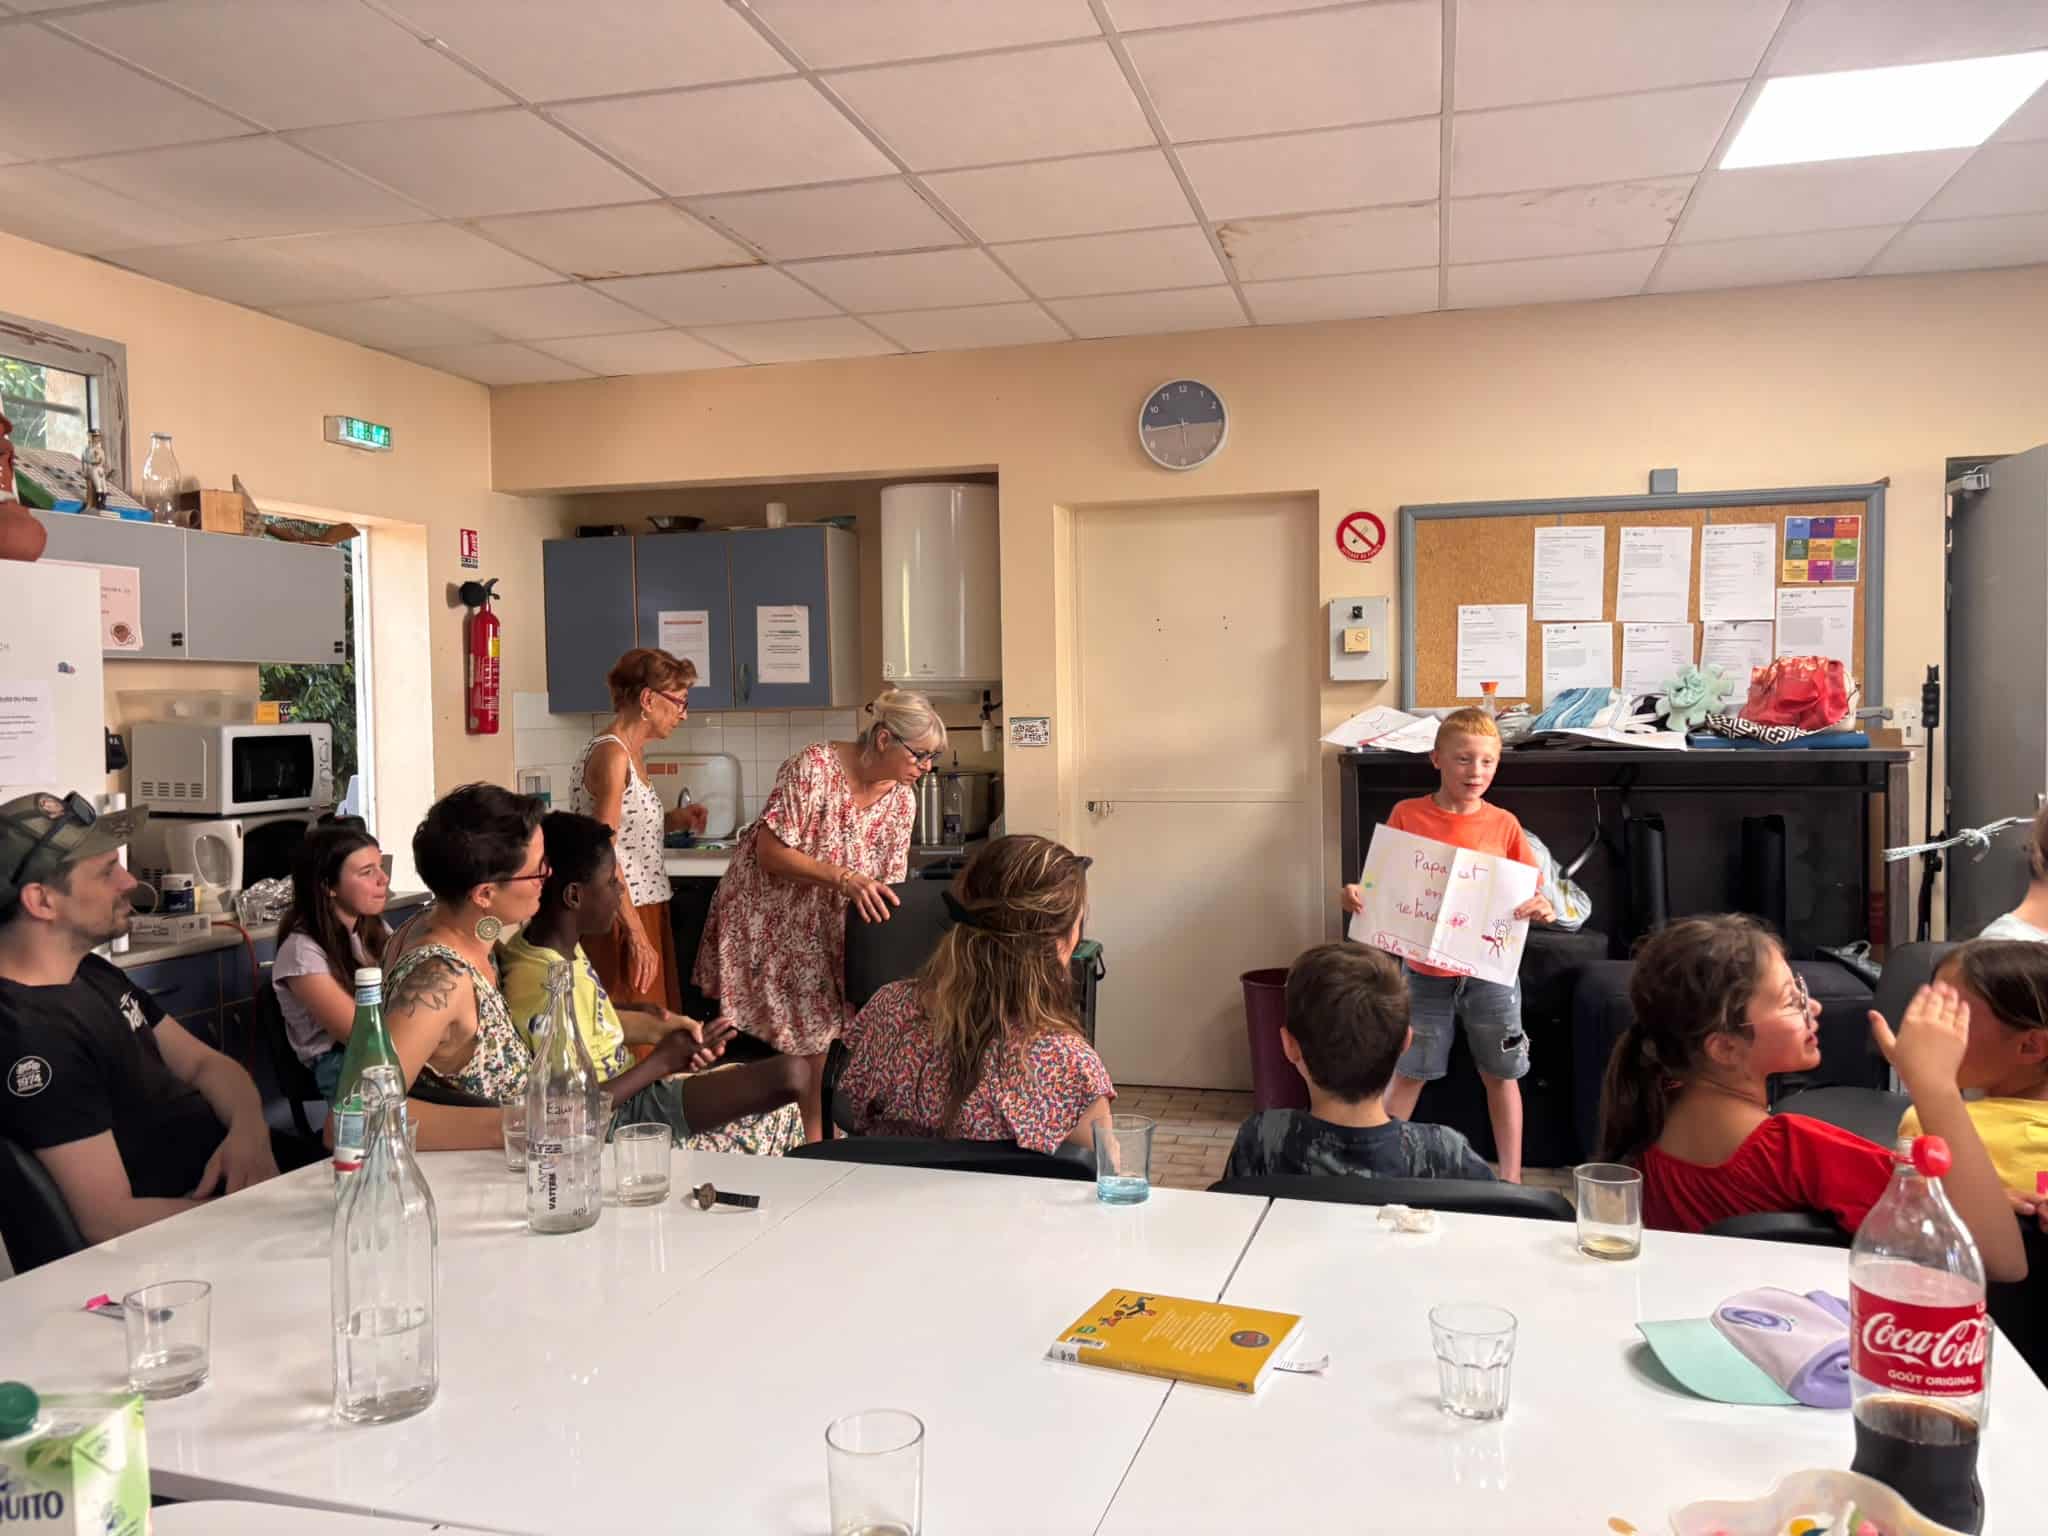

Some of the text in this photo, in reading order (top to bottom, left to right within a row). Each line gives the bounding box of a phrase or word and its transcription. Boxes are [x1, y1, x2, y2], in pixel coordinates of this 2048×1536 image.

[1178, 384, 1188, 393] 12
[1161, 392, 1170, 401] 11
[1211, 400, 1217, 409] 2
[1150, 405, 1160, 414] 10
[1415, 850, 1450, 880] Papa
[1887, 1368, 1977, 1387] GOÛT ORIGINAL
